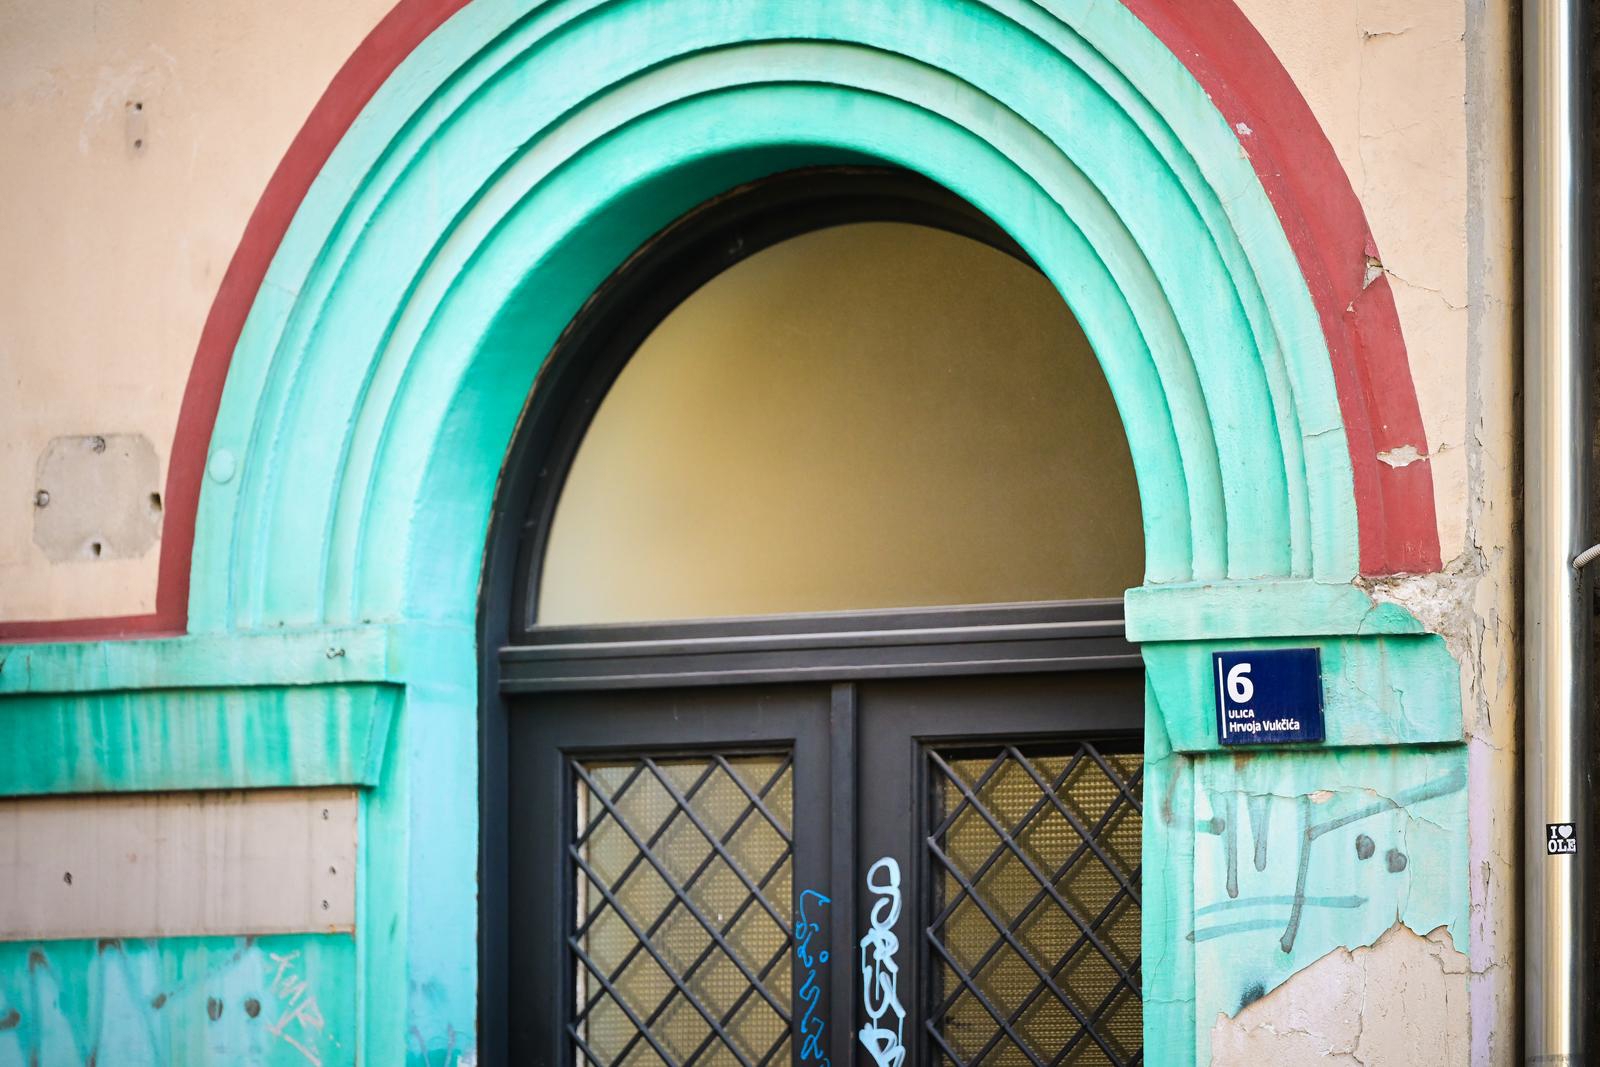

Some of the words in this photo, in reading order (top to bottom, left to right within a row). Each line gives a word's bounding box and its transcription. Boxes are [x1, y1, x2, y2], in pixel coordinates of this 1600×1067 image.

[1227, 663, 1254, 703] 6
[1228, 709, 1255, 719] ULICA
[1229, 721, 1261, 734] Hrvoja
[1262, 718, 1300, 731] Vukčića
[1548, 838, 1576, 853] OLE
